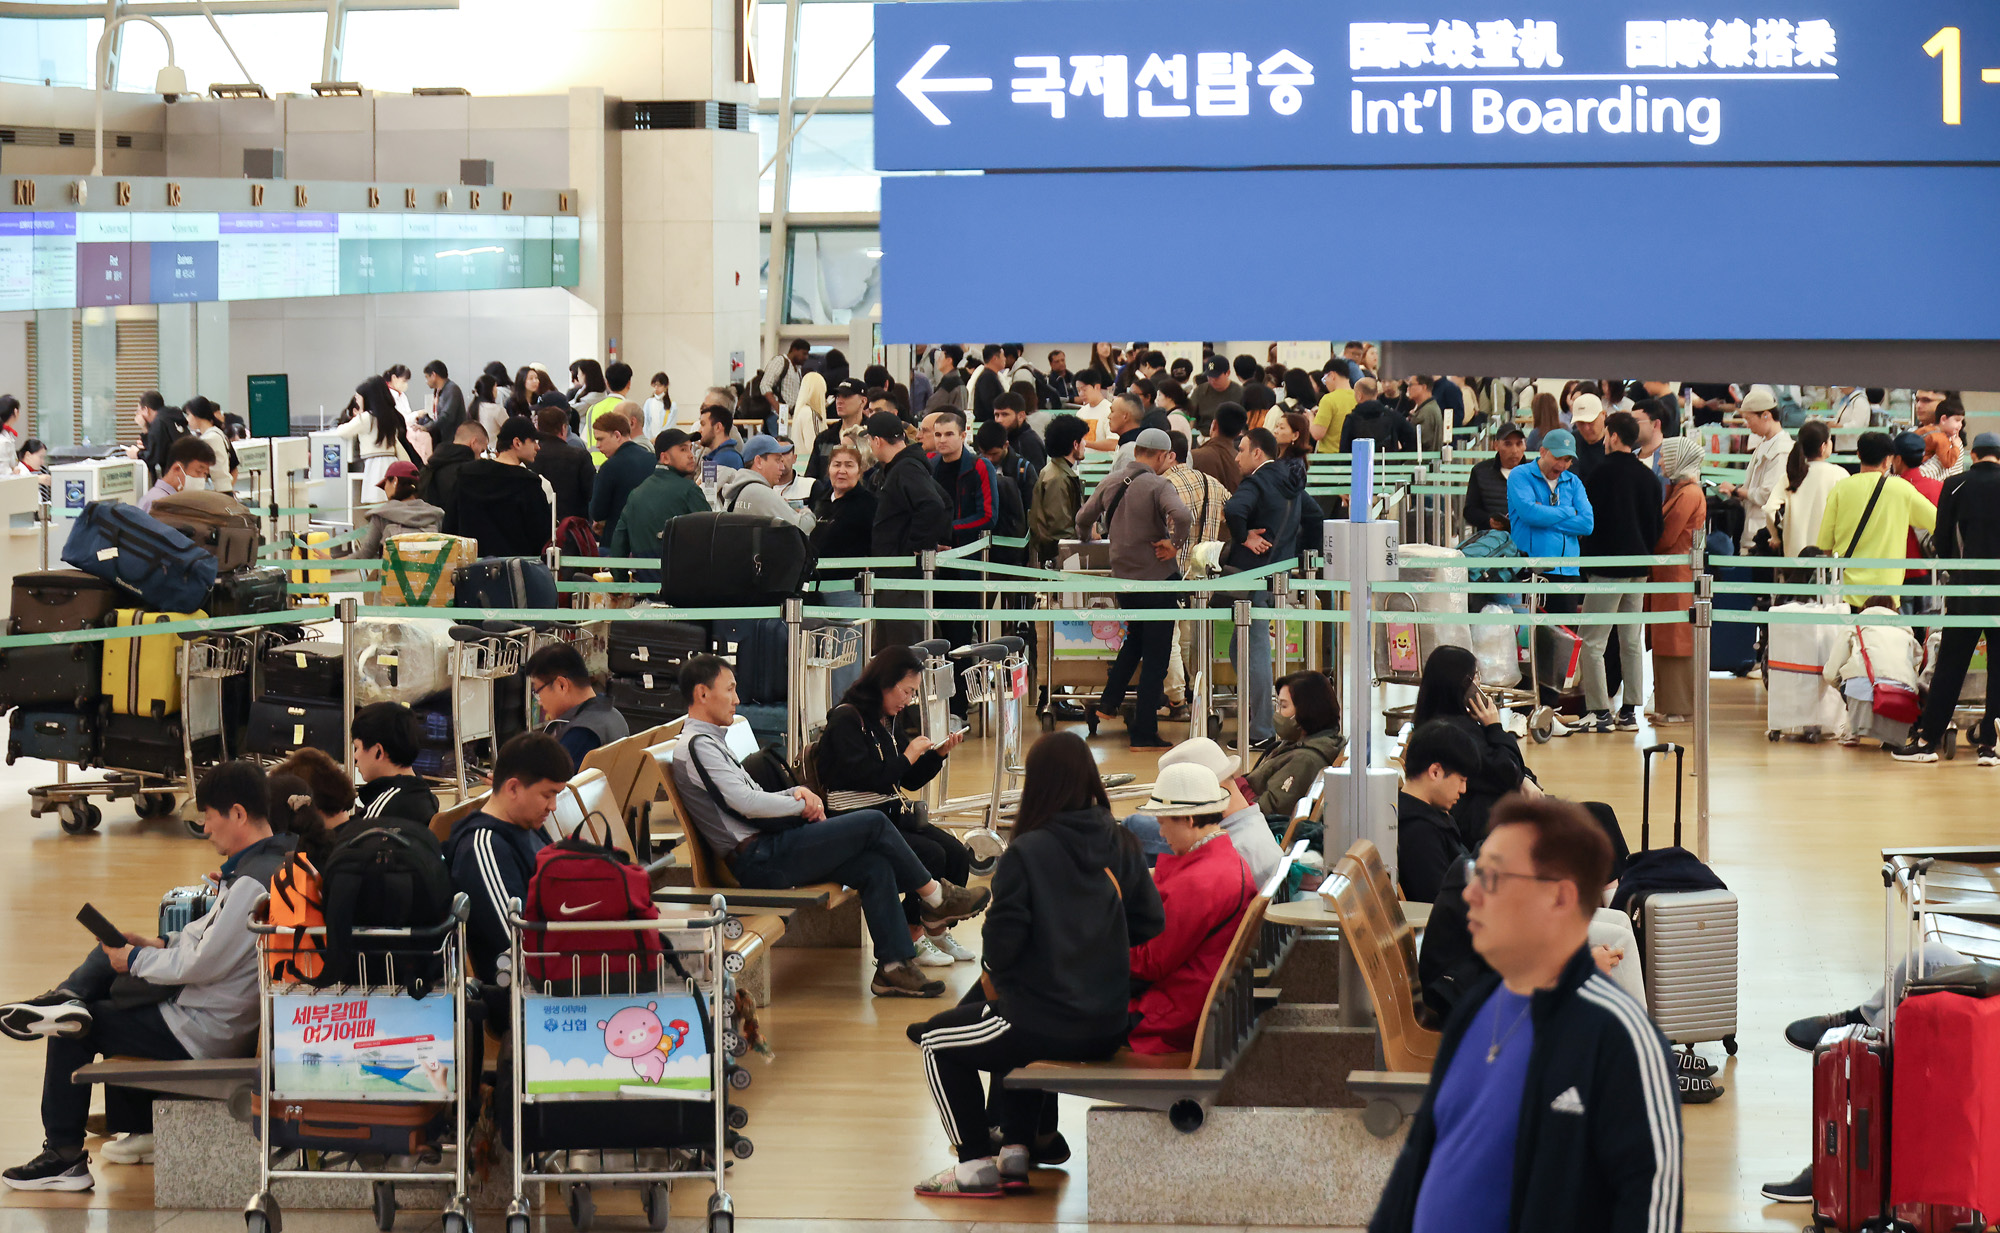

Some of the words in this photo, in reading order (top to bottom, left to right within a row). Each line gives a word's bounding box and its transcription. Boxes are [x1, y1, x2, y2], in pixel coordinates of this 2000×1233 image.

[1011, 48, 1315, 119] 국제선탑승
[1472, 84, 1721, 146] Boarding
[14, 179, 36, 206] K10
[117, 181, 132, 207] K9
[292, 1000, 368, 1026] 세부갈때
[561, 1018, 587, 1031] 신협
[303, 1018, 376, 1044] 여기어때
